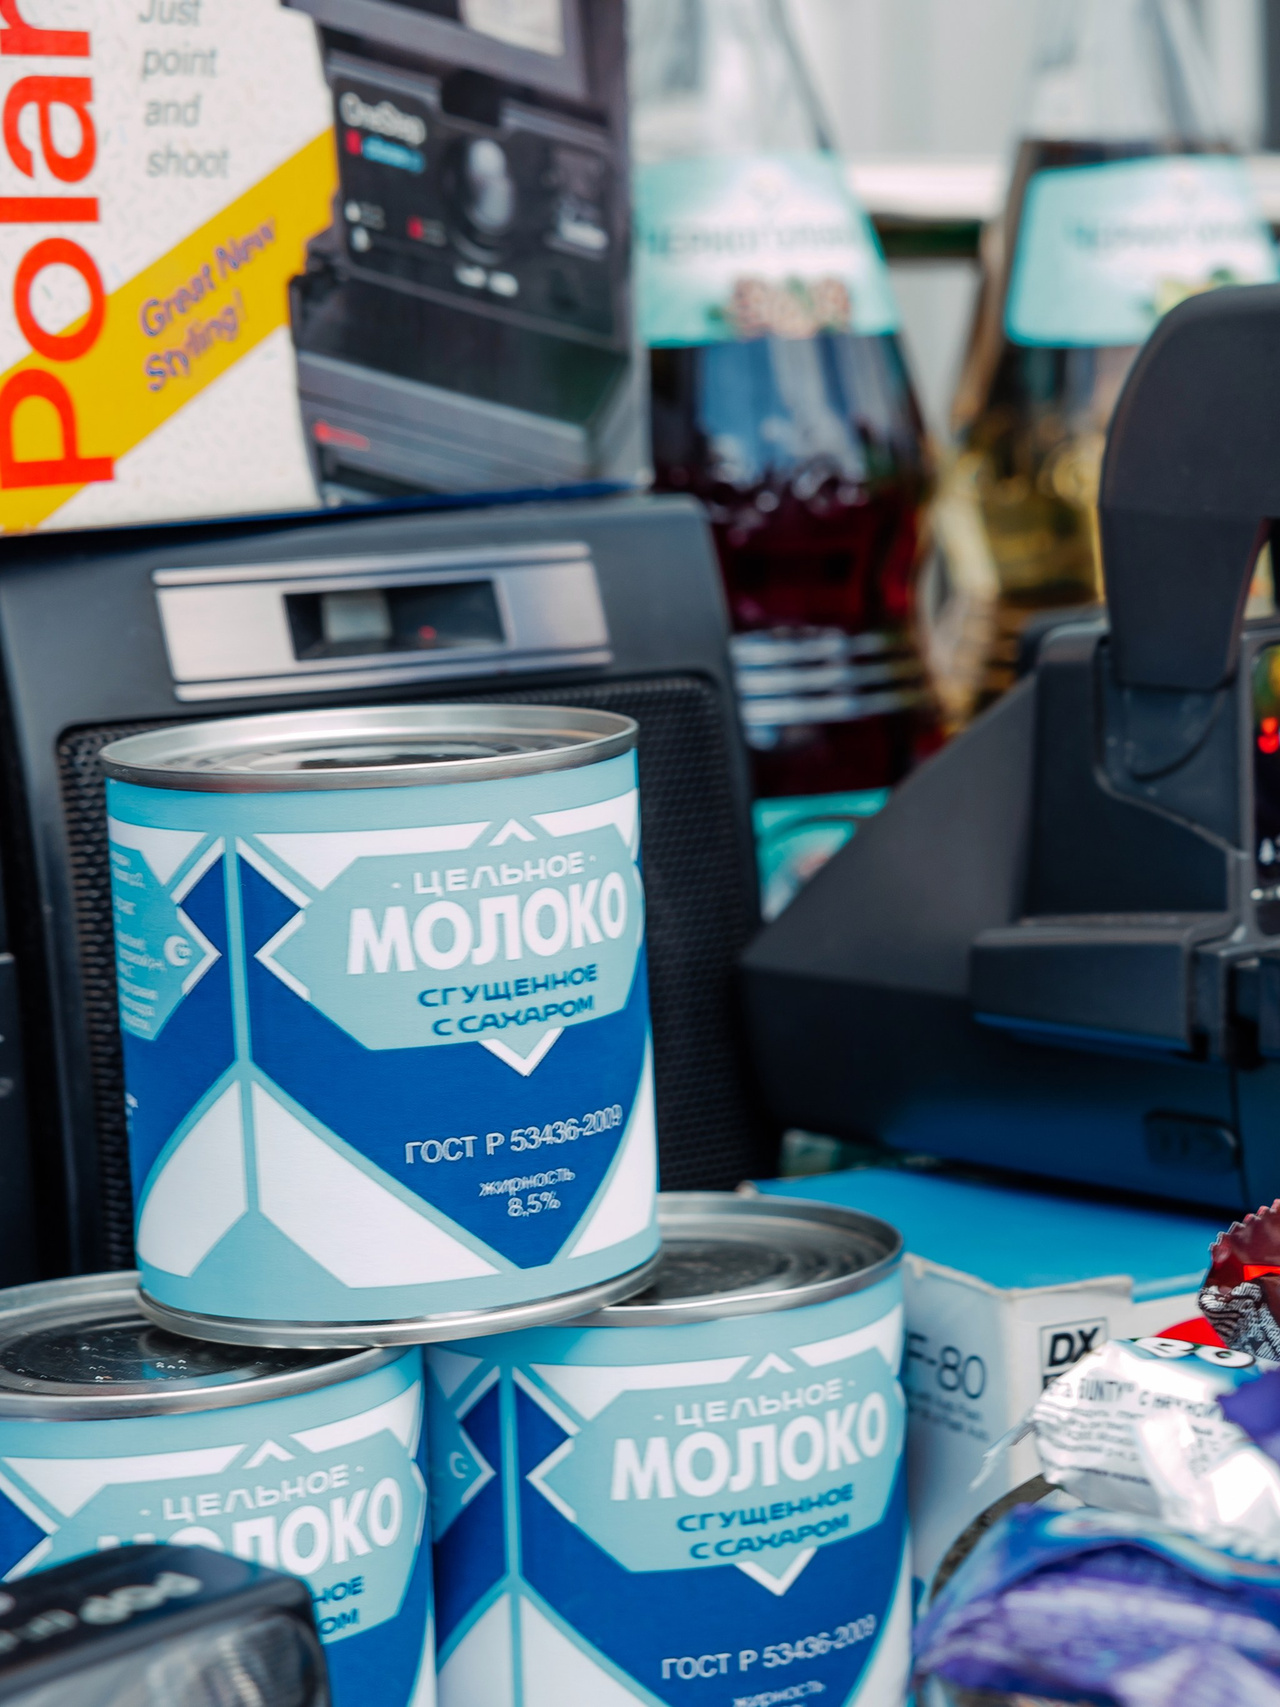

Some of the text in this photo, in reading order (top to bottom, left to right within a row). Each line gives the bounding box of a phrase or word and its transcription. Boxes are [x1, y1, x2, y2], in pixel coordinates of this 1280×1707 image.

[142, 40, 219, 81] point
[144, 94, 202, 127] and
[145, 144, 231, 179] shoot
[139, 216, 276, 337] Great New
[413, 851, 585, 897] ЦЕЛЬНОЕ
[346, 871, 628, 975] МОЛОКО
[417, 963, 598, 1008] СГУЩЕННОЕ
[458, 994, 596, 1034] САХАРОМ
[404, 1135, 478, 1164] ГОСТ
[486, 1132, 505, 1156] Р
[478, 1167, 576, 1197] жирность
[1049, 1327, 1100, 1368] DX
[674, 1378, 843, 1427] ЦЕЛЬНОЕ
[610, 1392, 888, 1501] МОЛОКО
[162, 1464, 351, 1523] ЦЕЛЬНОЕ
[676, 1483, 855, 1532] СГУЩЕННОЕ
[97, 1477, 403, 1576] ЛОКО
[714, 1513, 850, 1557] САХАРОМ
[661, 1653, 732, 1680] ГОСТ
[738, 1650, 759, 1672] Р
